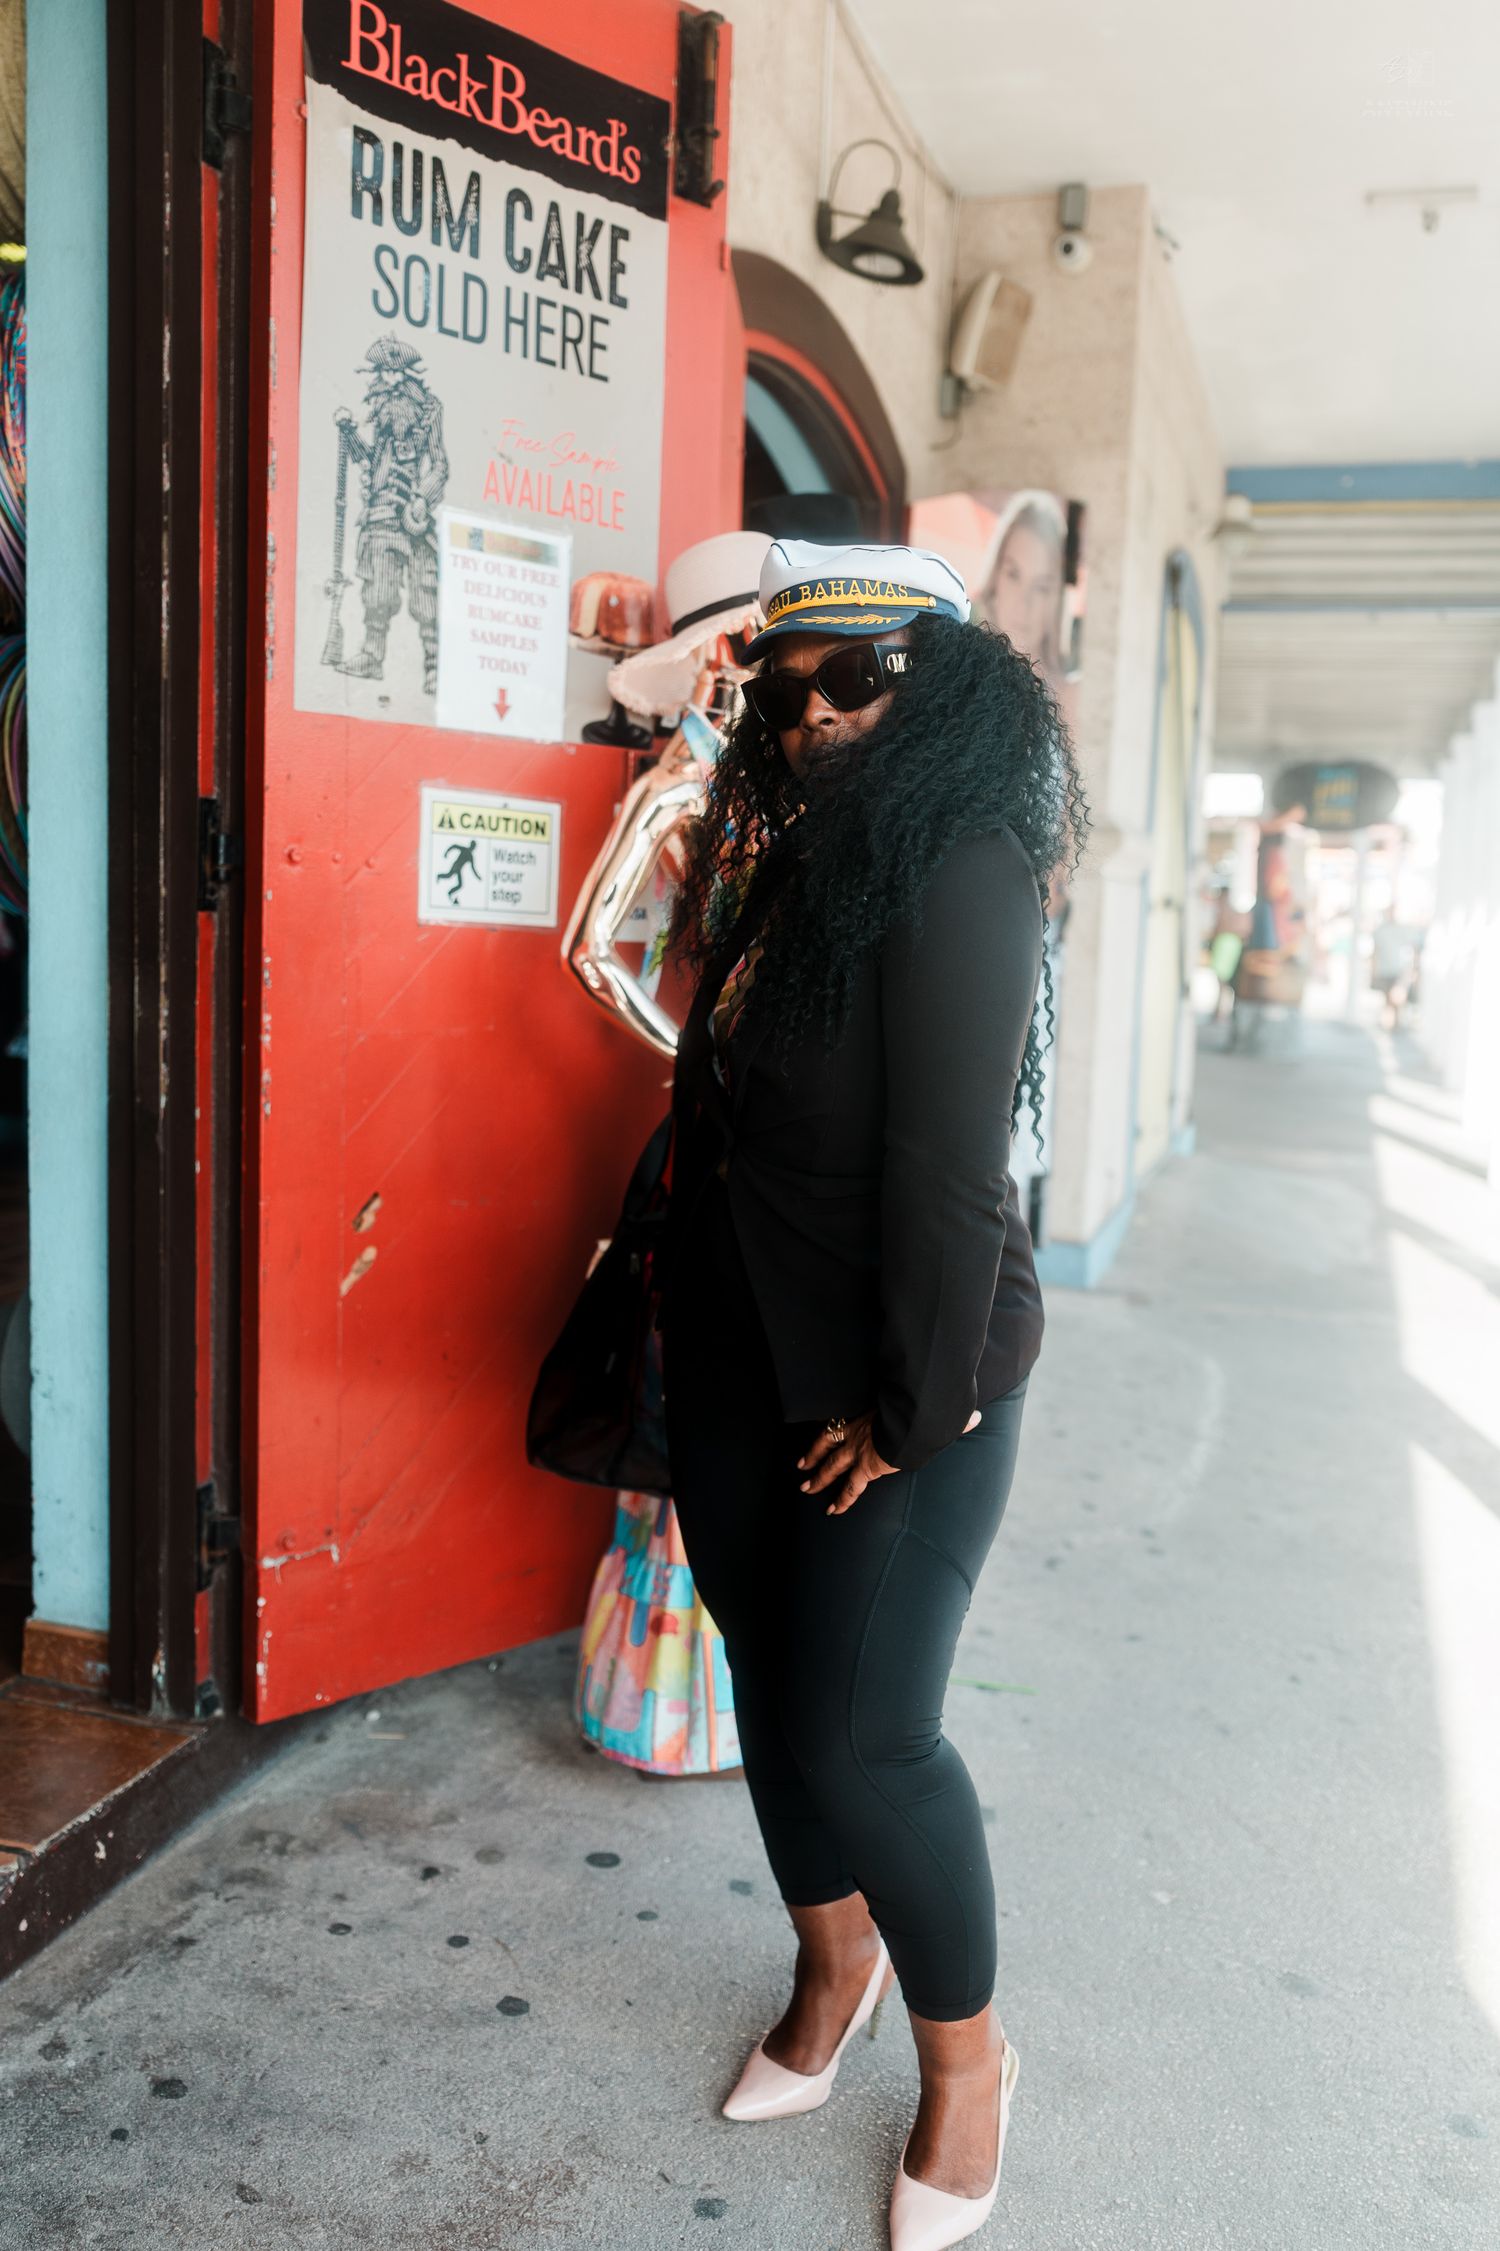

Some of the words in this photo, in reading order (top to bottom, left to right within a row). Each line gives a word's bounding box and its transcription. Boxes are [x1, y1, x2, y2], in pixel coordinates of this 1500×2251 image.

[340, 0, 642, 185] BlackBeard's
[350, 124, 481, 260] RUM
[504, 187, 631, 310] CAKE
[371, 243, 488, 345] SOLD
[503, 286, 610, 383] HERE
[497, 418, 548, 452] Free
[483, 460, 626, 532] AVAILABLE
[450, 553, 479, 572] TRY
[483, 560, 518, 579] OUR
[521, 567, 561, 588] FREE
[463, 579, 548, 608] DELICIOUS
[799, 579, 910, 601] BAHAMAS
[467, 604, 543, 631] RUMCAKE
[470, 628, 539, 653] SAMPLES
[477, 654, 531, 676] TODAY
[460, 812, 547, 836] CAUTION
[493, 848, 537, 866] Watch
[492, 872, 524, 886] your
[491, 889, 522, 906] step
